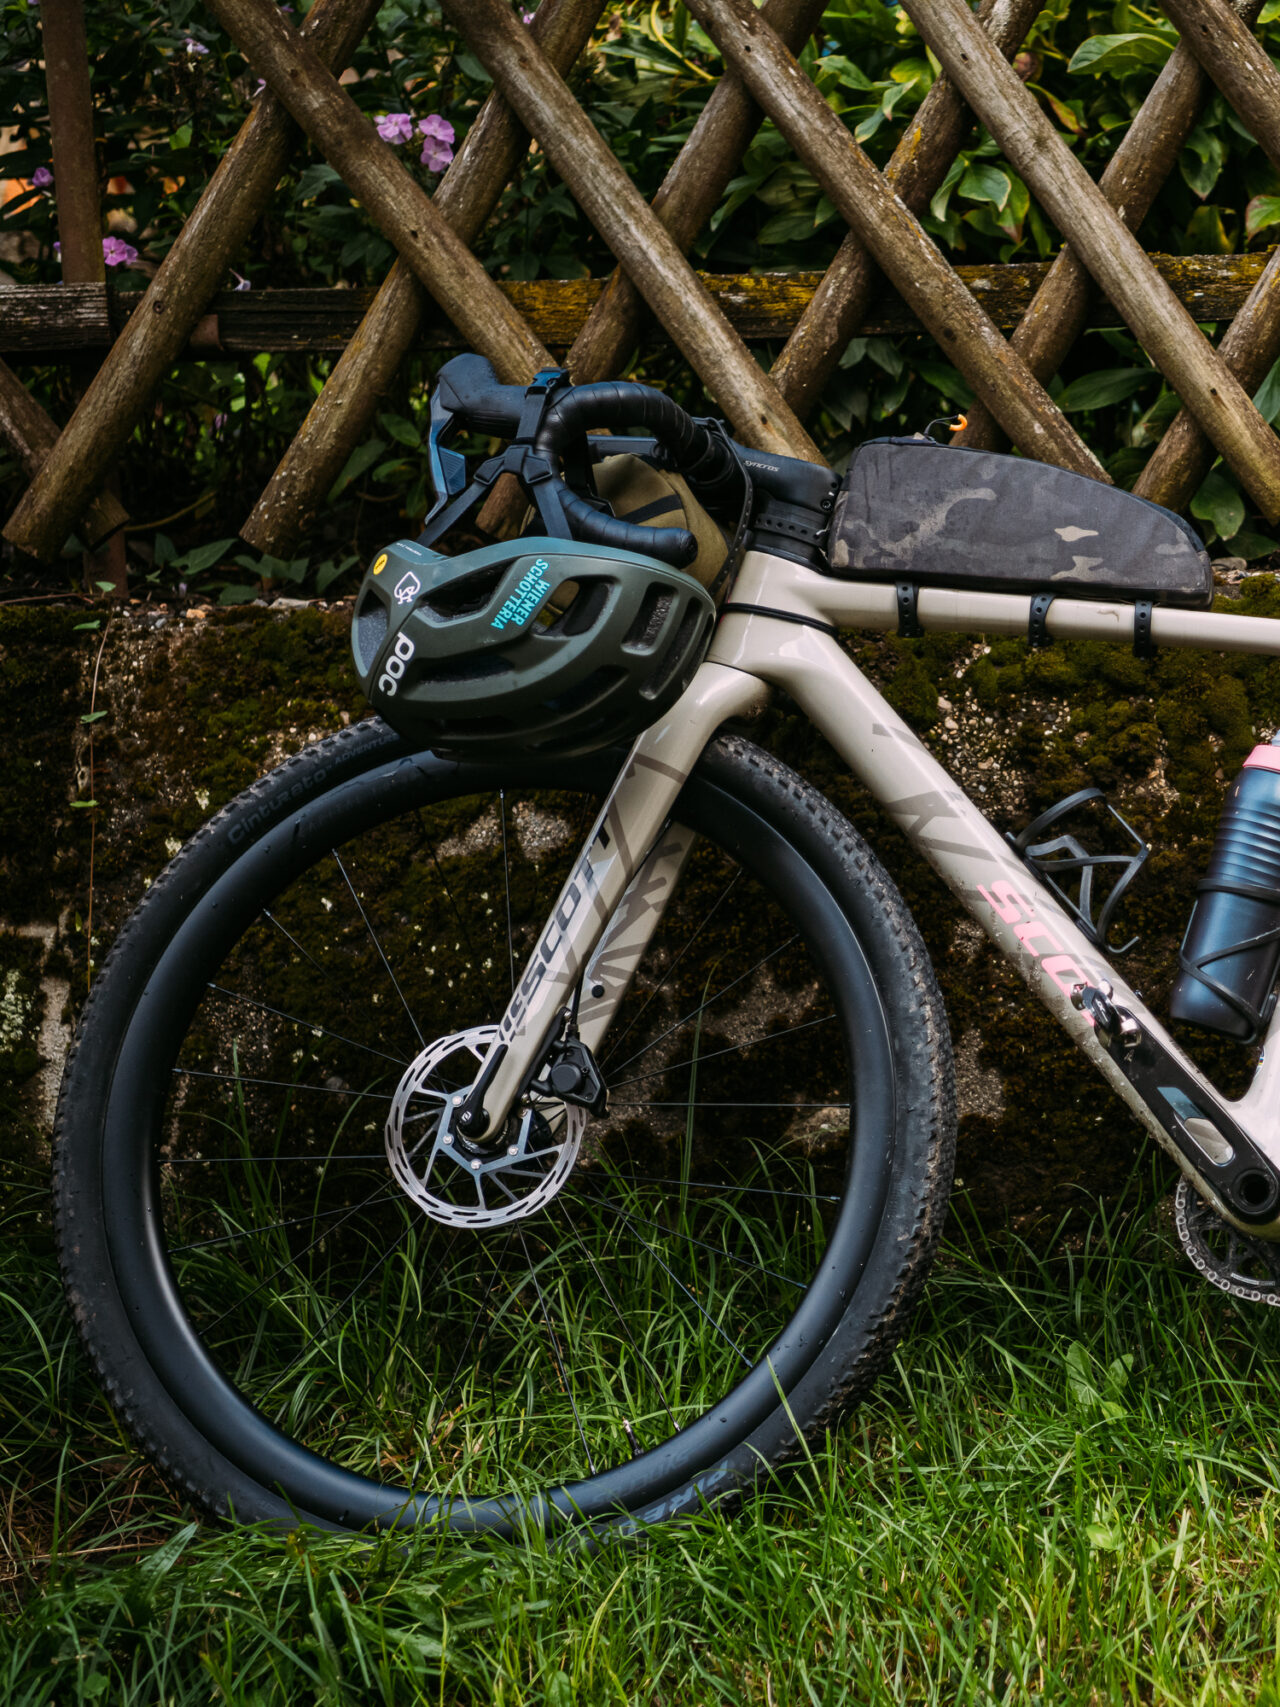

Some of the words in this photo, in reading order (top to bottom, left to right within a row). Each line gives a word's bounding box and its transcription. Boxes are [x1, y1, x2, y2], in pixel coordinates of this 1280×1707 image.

[490, 558, 549, 630] SCHOTTERIA
[510, 578, 551, 627] WIENER
[378, 631, 416, 697] POC
[520, 813, 611, 1006] SCOTT
[975, 879, 1100, 1028] SCO
